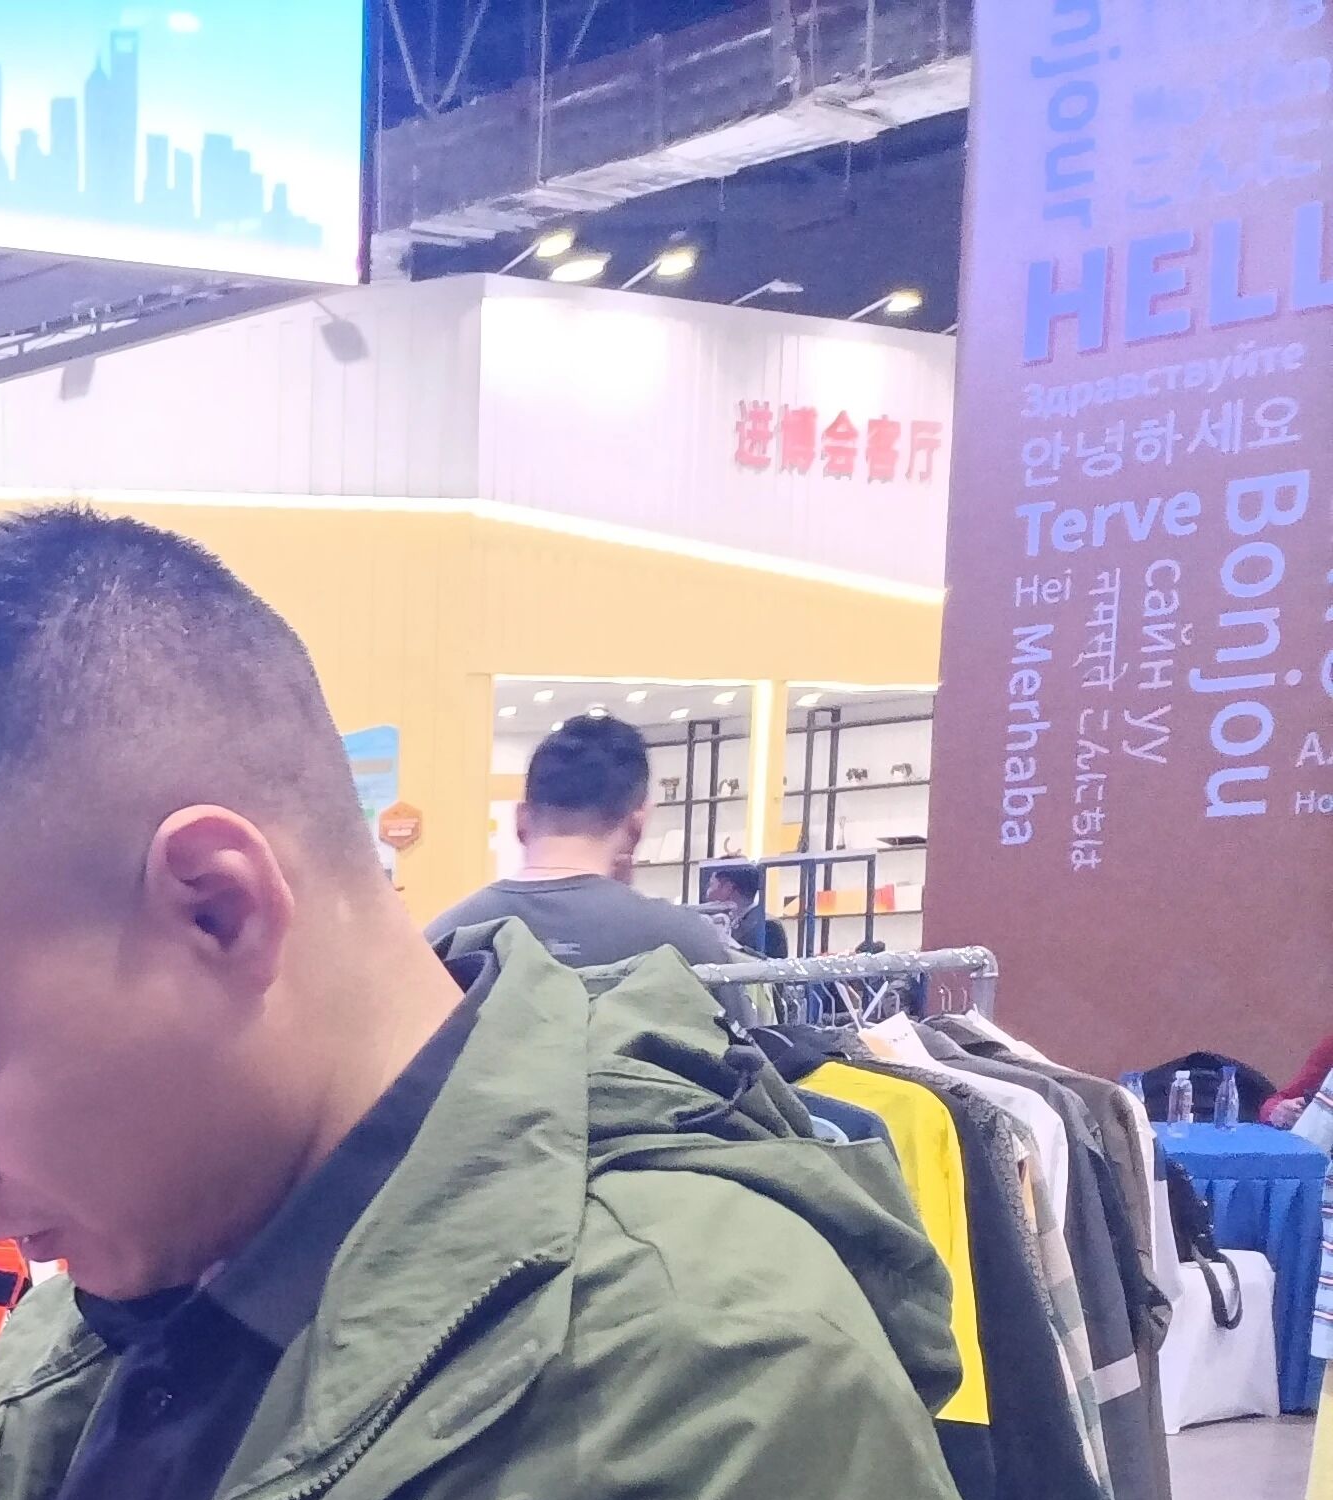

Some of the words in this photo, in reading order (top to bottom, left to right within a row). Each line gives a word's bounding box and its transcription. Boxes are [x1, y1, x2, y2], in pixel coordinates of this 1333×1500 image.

[735, 400, 943, 483] 进博会客厅
[1022, 397, 1301, 487] 안녕하세요
[1015, 491, 1202, 556] Terve
[1015, 569, 1072, 607] Hei
[1073, 567, 1128, 691] नमस्ते
[1000, 624, 1054, 846] Merhaba
[1072, 706, 1109, 871] こんにちは
